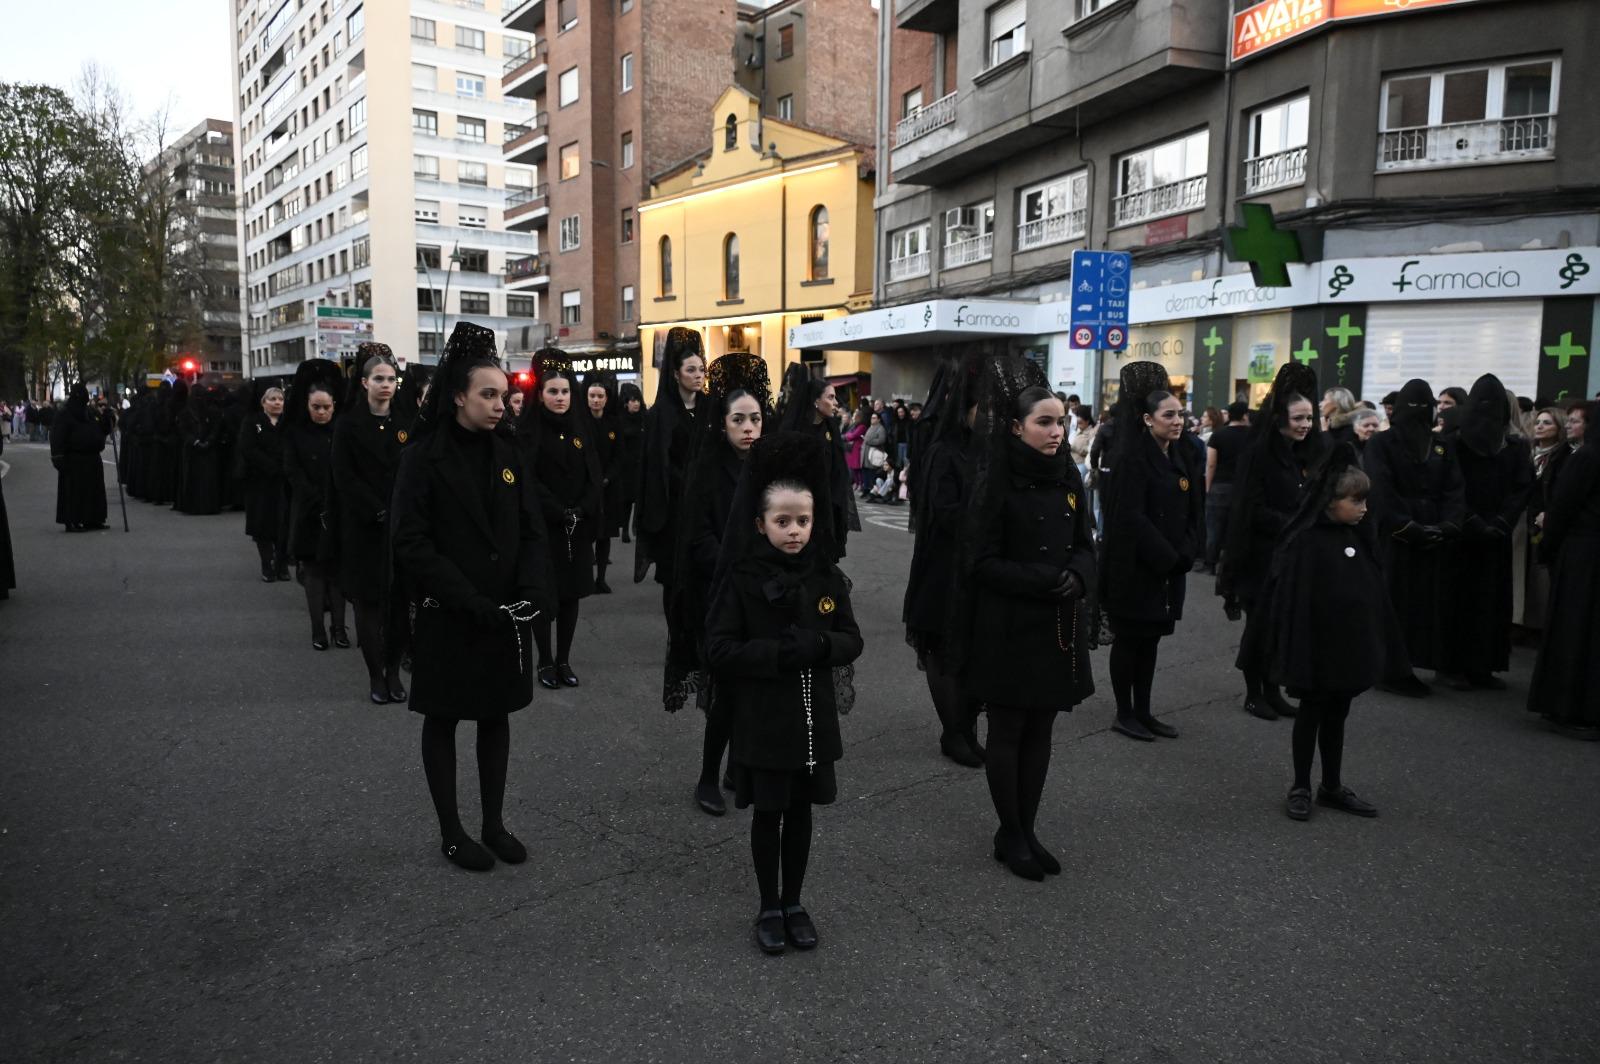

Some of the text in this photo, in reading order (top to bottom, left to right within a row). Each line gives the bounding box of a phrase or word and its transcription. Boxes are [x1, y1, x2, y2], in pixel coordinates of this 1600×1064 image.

[1392, 260, 1520, 293] farmacia
[953, 305, 1020, 327] farmacia
[1108, 311, 1124, 319] BUS
[1111, 333, 1120, 341] 20
[571, 360, 593, 372] NICA
